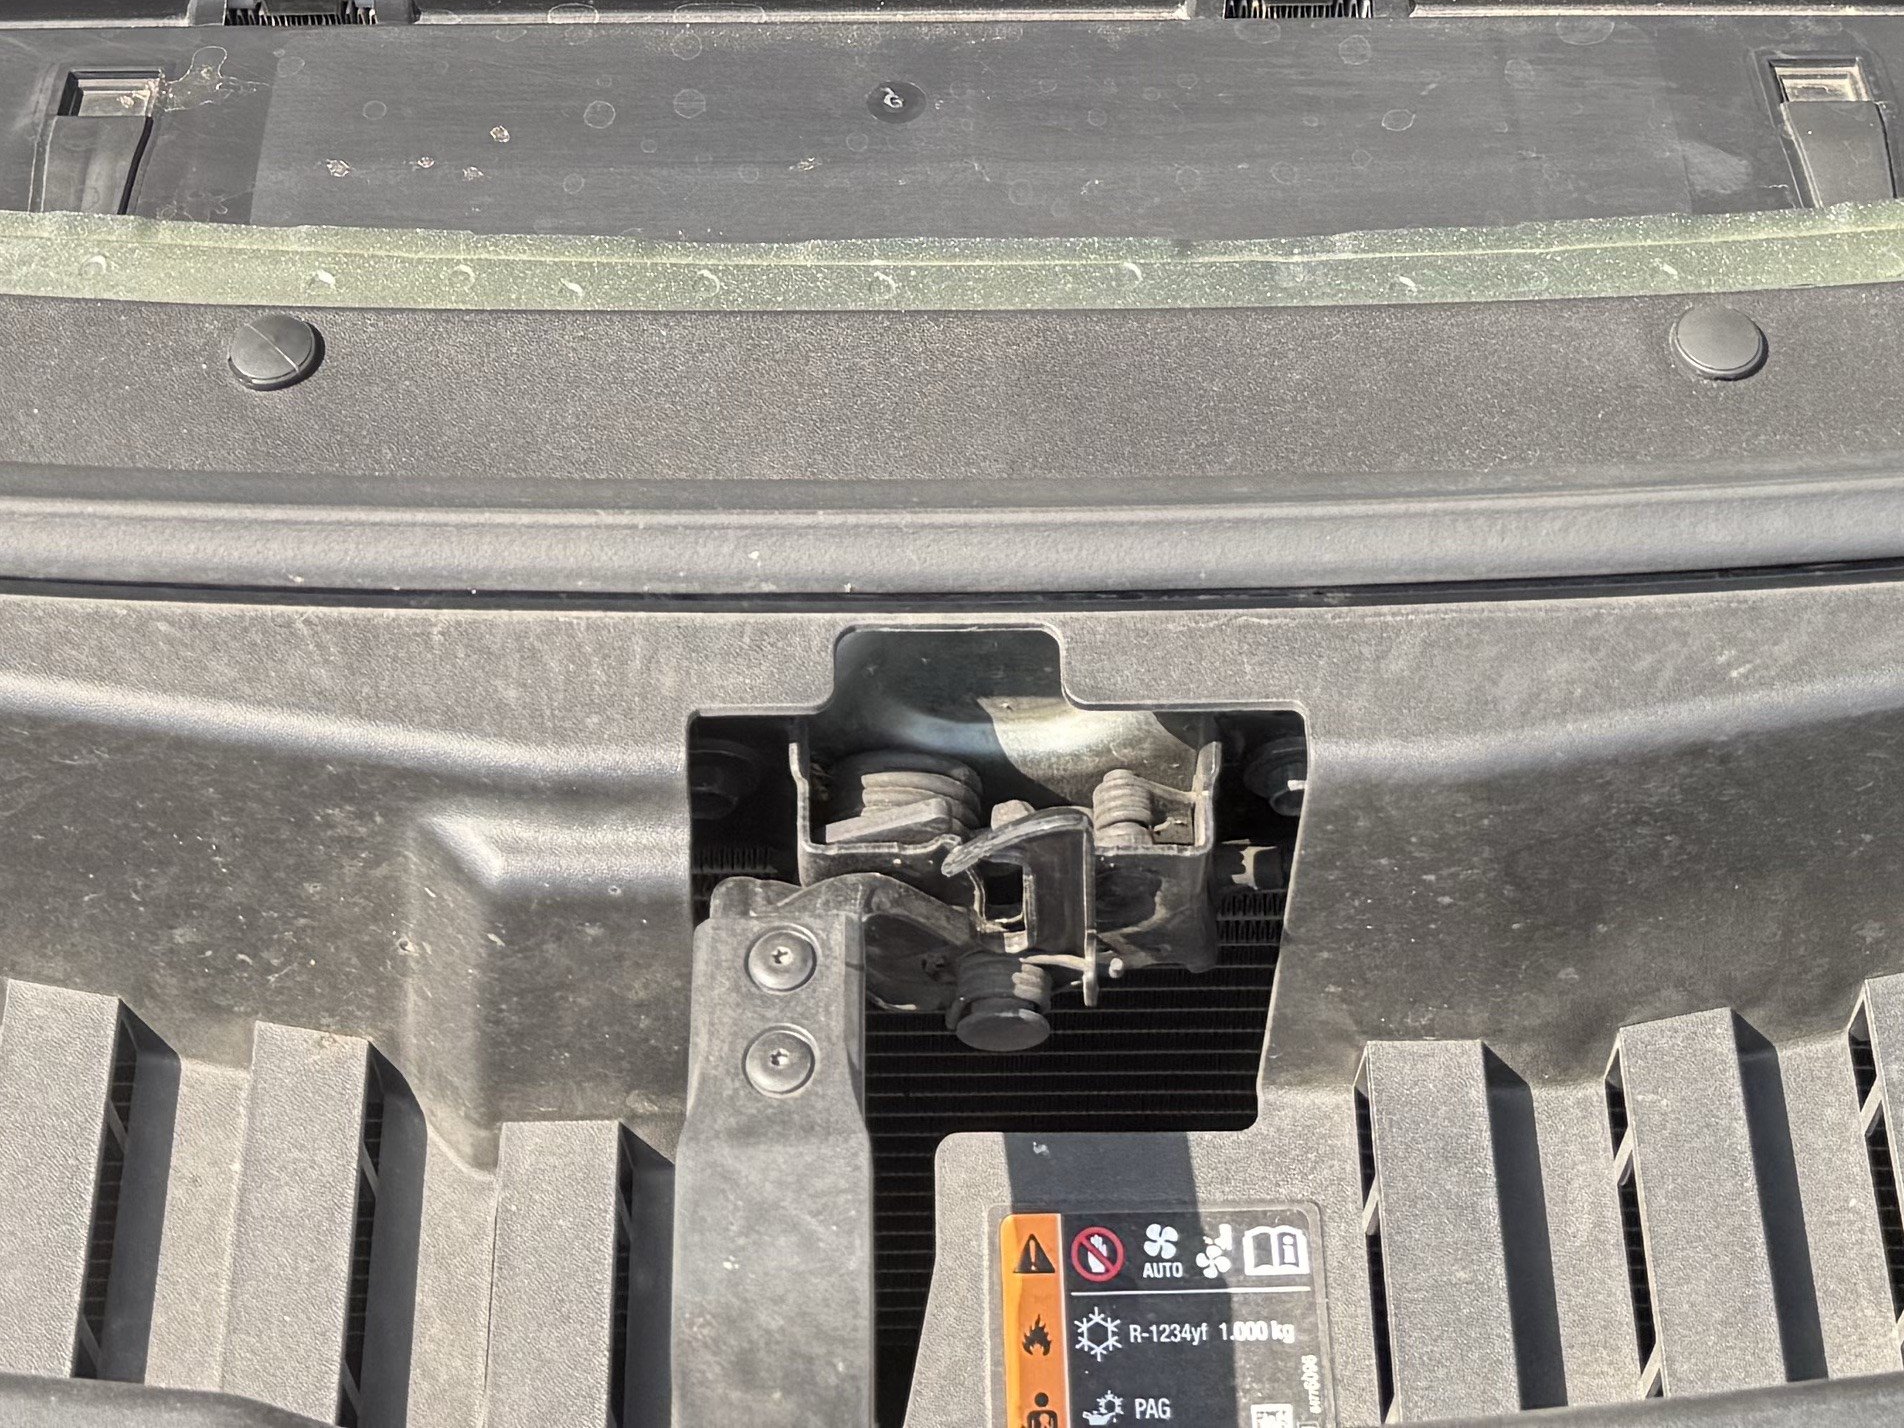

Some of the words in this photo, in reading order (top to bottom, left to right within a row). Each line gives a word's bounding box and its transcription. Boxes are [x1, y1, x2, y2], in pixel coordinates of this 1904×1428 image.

[1142, 1261, 1184, 1279] AUTO
[1128, 1322, 1209, 1346] R-1234yf
[1218, 1320, 1269, 1342] 1.000
[1270, 1320, 1296, 1344] kg
[1134, 1397, 1172, 1420] PAG
